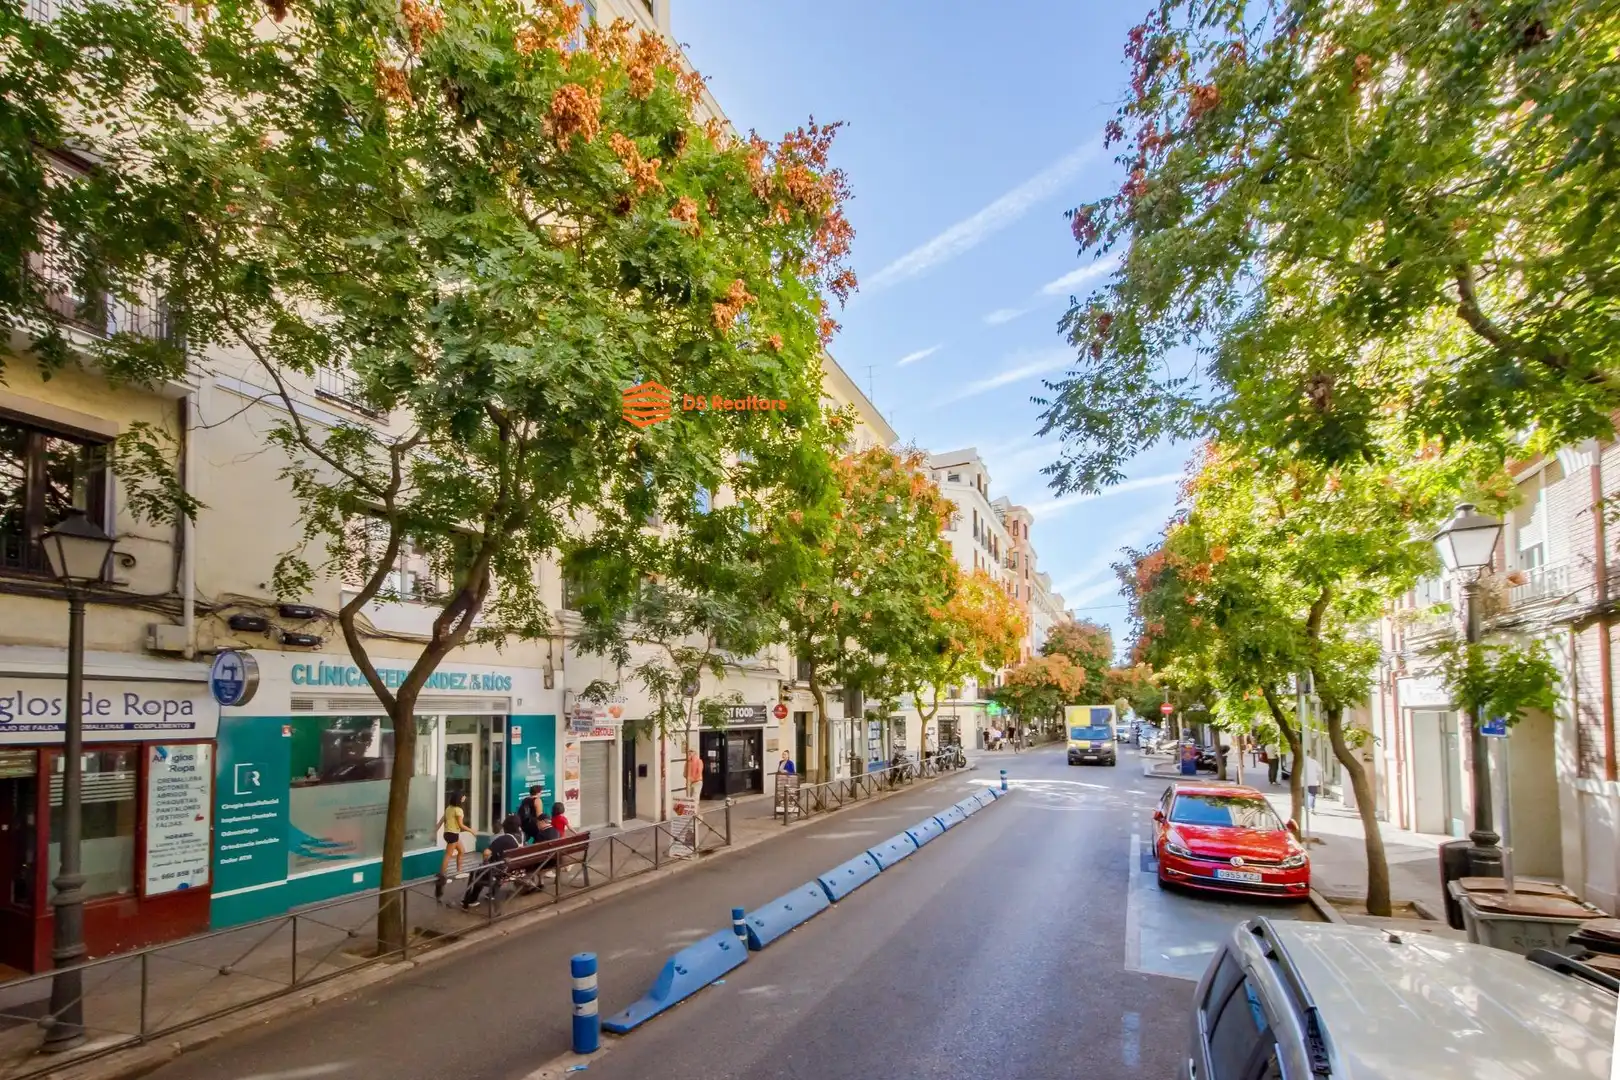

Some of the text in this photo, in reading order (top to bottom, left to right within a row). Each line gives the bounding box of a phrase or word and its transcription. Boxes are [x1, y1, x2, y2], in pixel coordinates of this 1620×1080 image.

[291, 660, 467, 690] CLÍNICA FERNDEZ
[482, 671, 513, 691] RÍOS
[123, 692, 193, 722] Ropa
[735, 707, 754, 718] FOOD
[168, 764, 196, 773] Ropa
